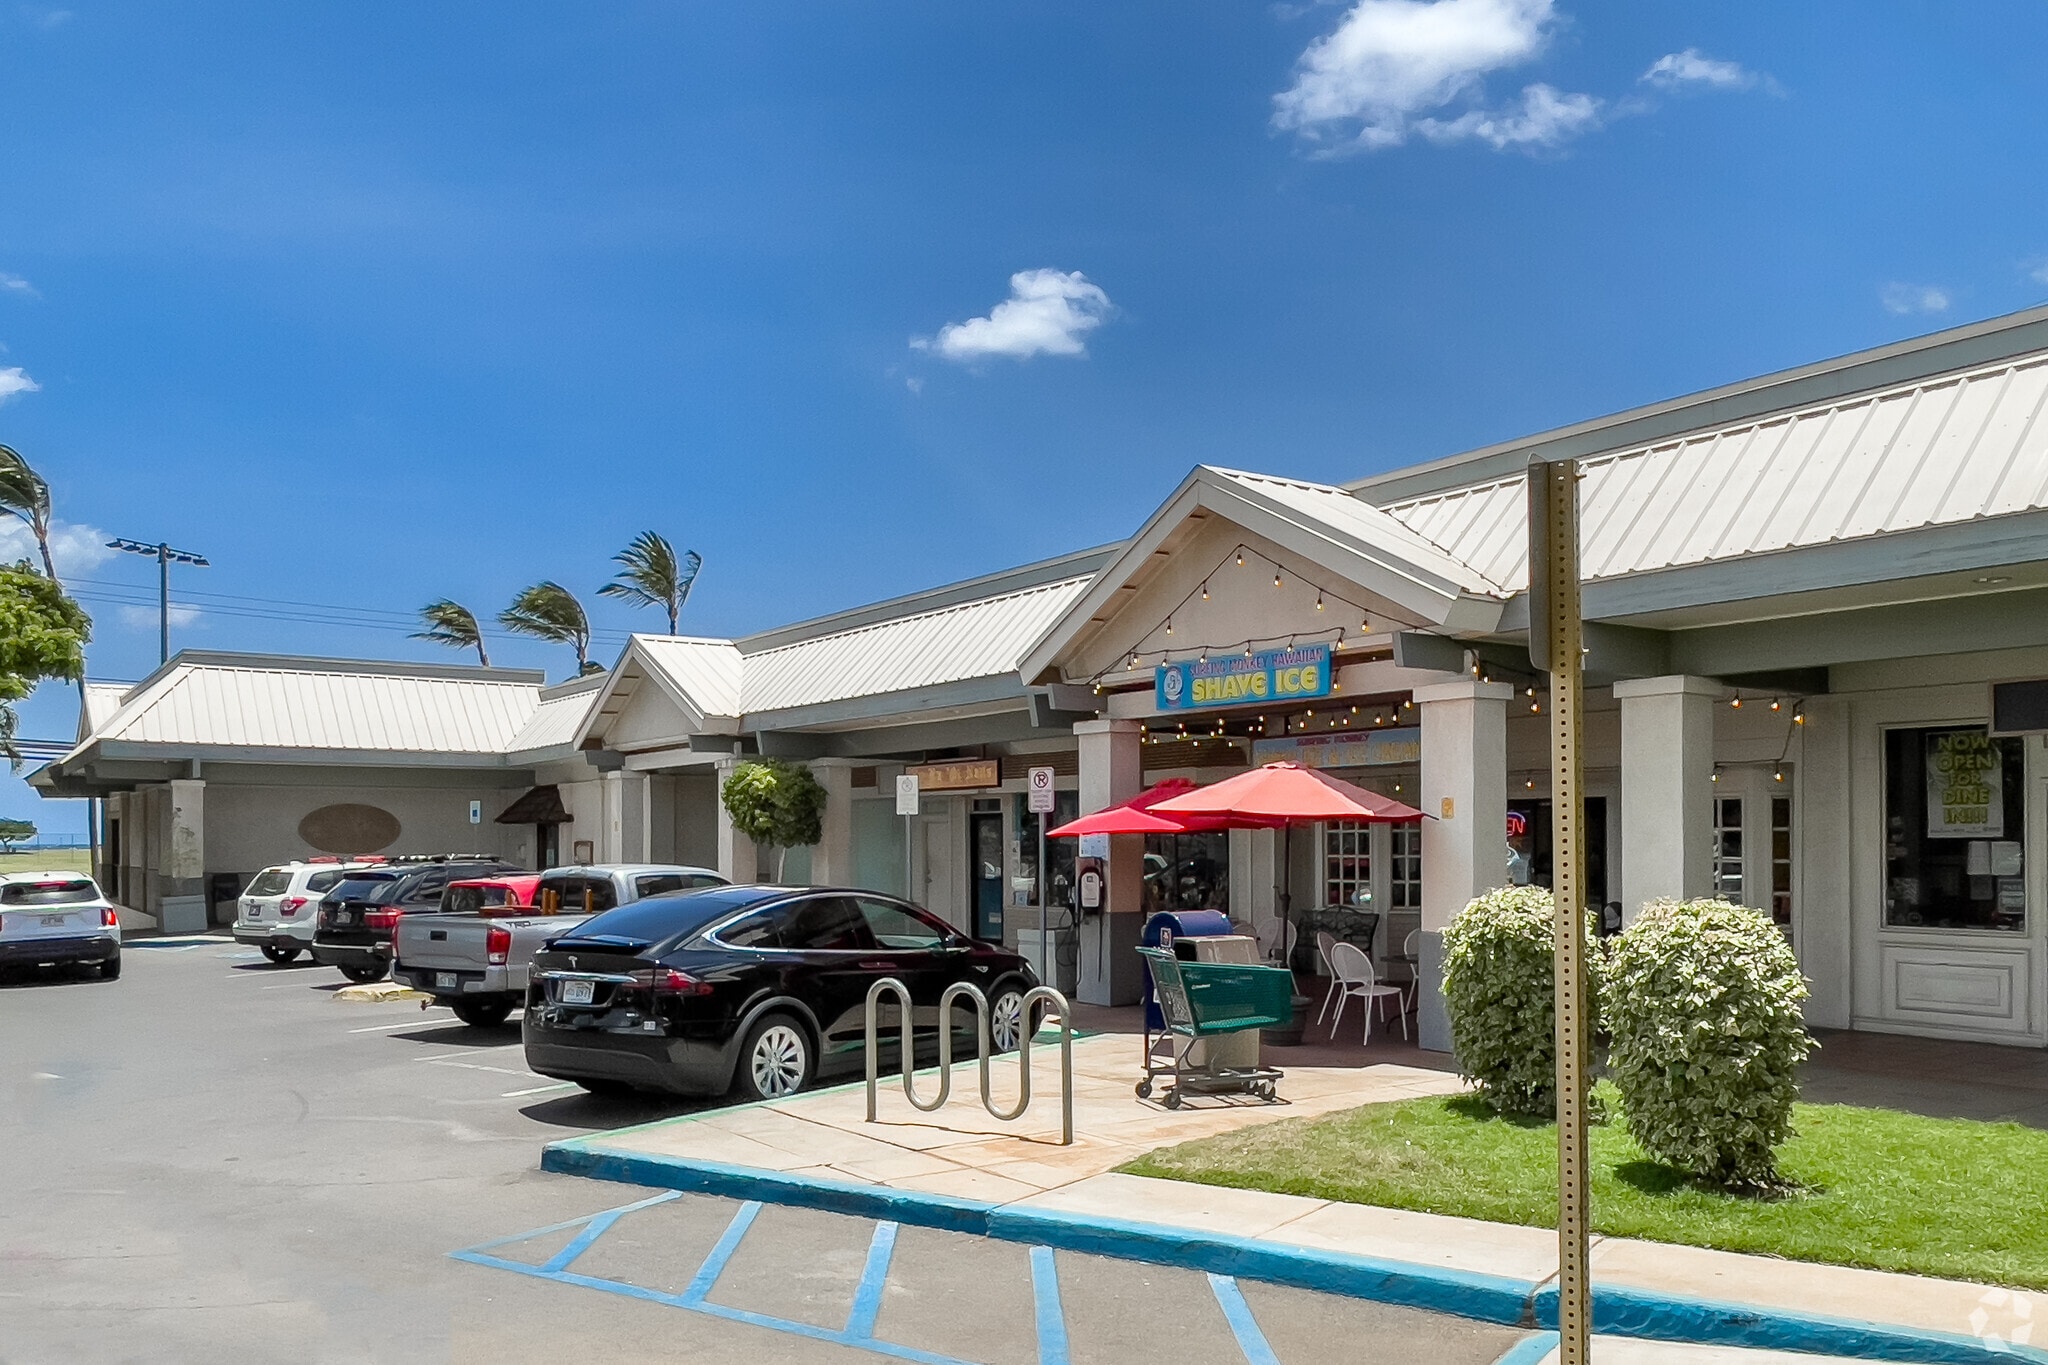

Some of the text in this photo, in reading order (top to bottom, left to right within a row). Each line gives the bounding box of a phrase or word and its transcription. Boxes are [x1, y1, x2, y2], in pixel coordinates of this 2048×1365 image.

[1192, 665, 1319, 703] SHAVE ICE
[1938, 735, 1990, 751] NOW
[1936, 753, 1993, 771] OPEN
[1949, 771, 1982, 787] FOR
[1943, 788, 1990, 805] DINE
